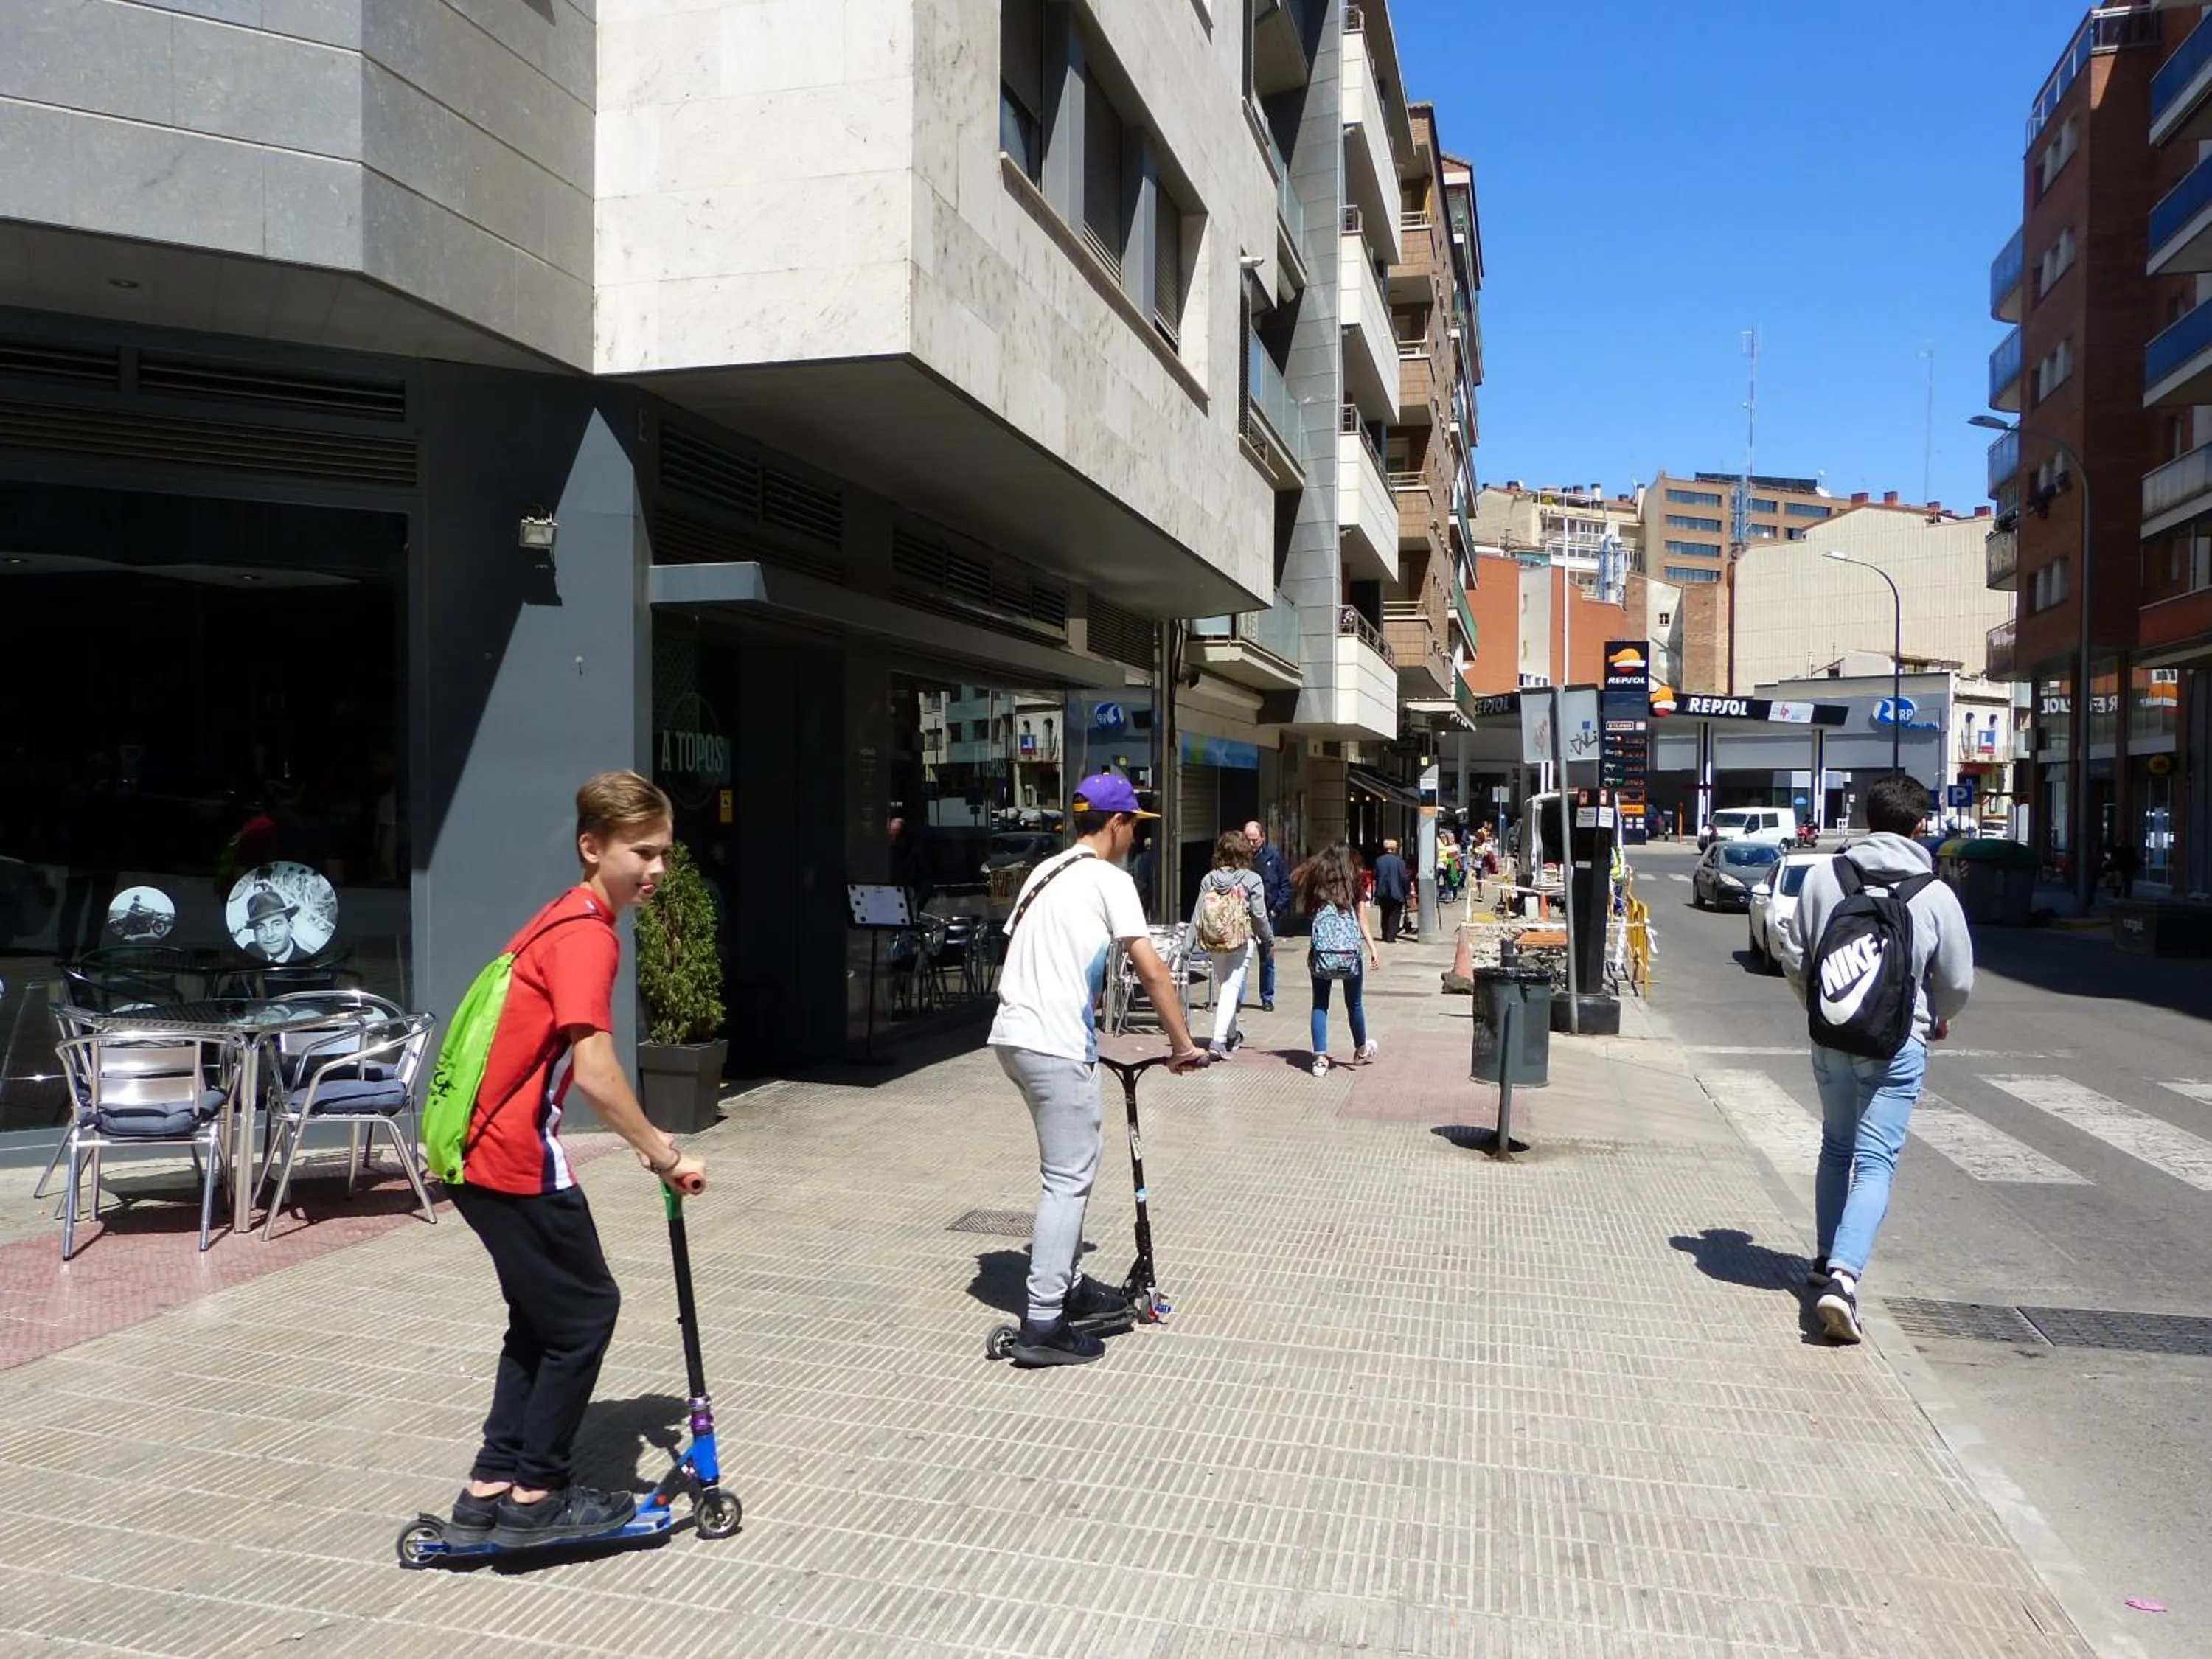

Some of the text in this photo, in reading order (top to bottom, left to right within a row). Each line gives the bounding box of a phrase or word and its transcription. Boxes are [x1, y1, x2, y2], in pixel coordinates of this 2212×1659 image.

[1608, 676, 1646, 684] REPSOL
[1688, 697, 1747, 716] REPSOL
[661, 729, 723, 773] A TOPOS
[1952, 787, 1969, 805] P
[1820, 933, 1880, 995] NIKE
